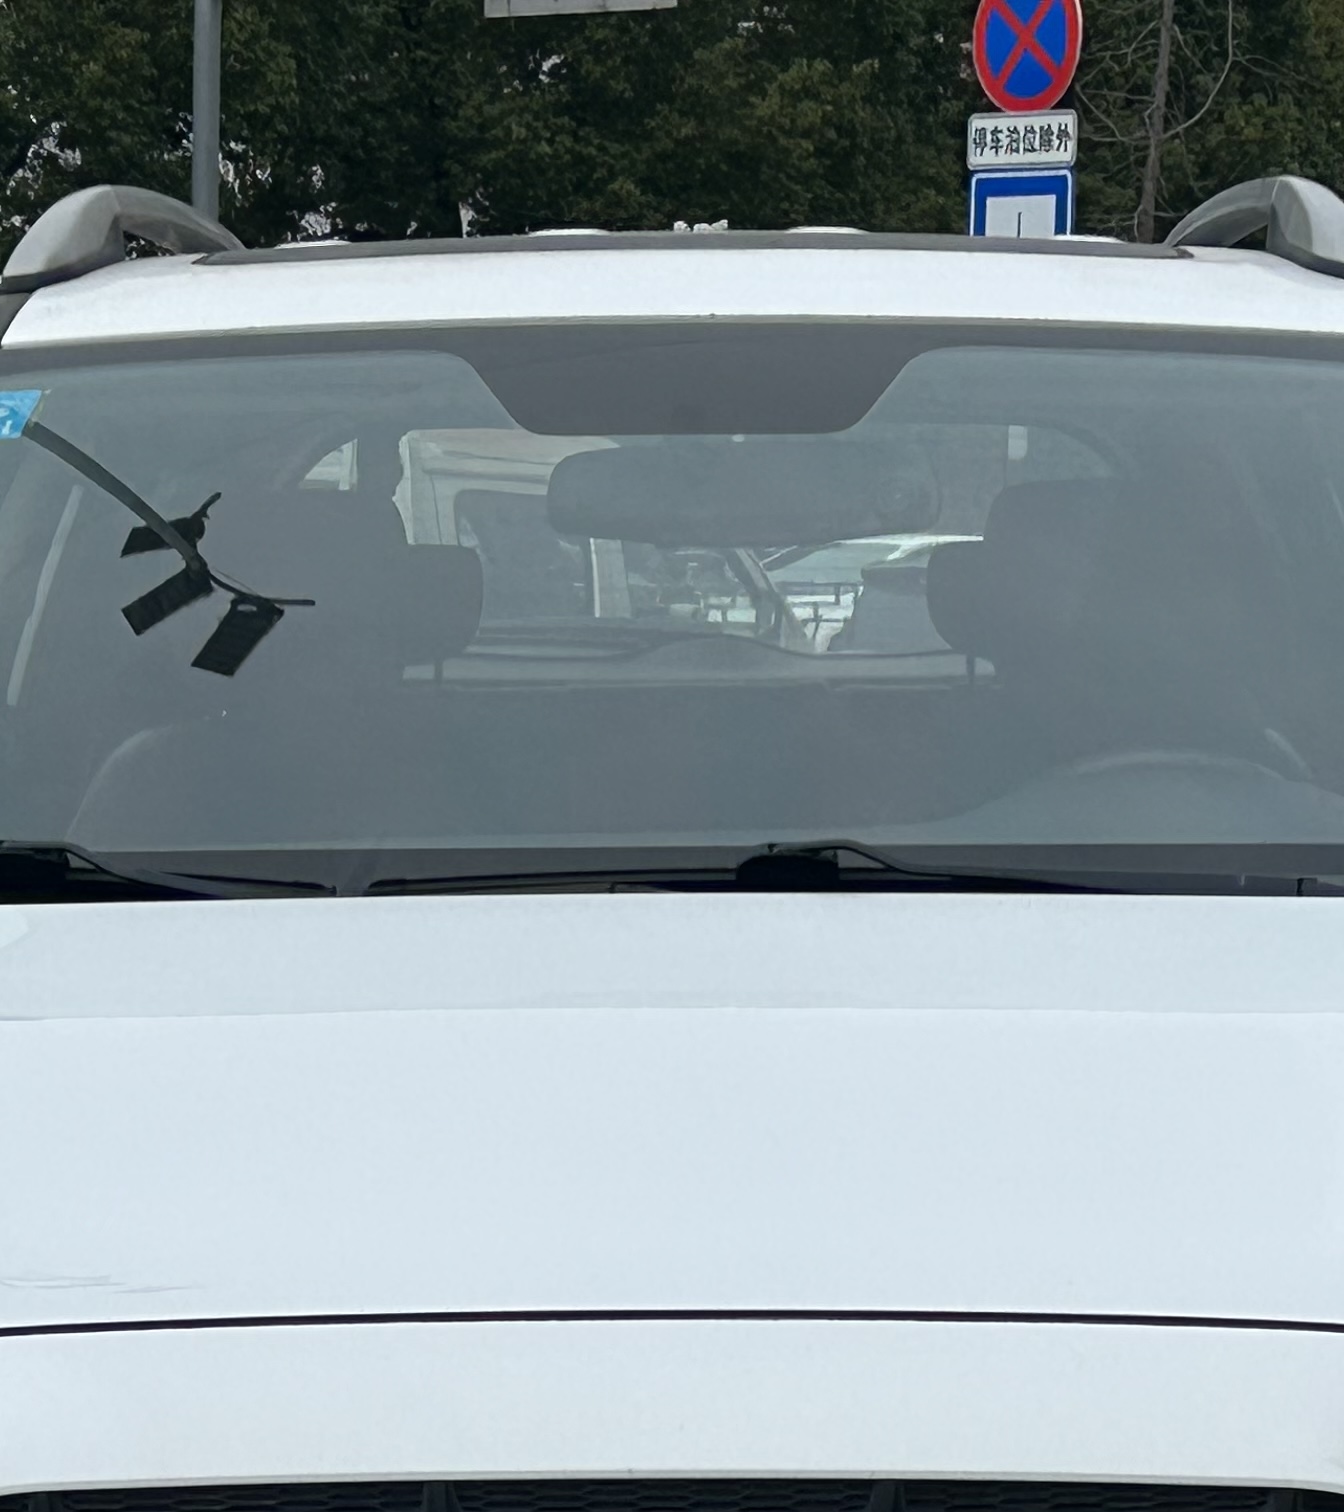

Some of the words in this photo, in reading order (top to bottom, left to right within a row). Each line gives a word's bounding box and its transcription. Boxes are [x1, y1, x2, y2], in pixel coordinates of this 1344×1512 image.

[972, 123, 1072, 156] 停车泊位除外
